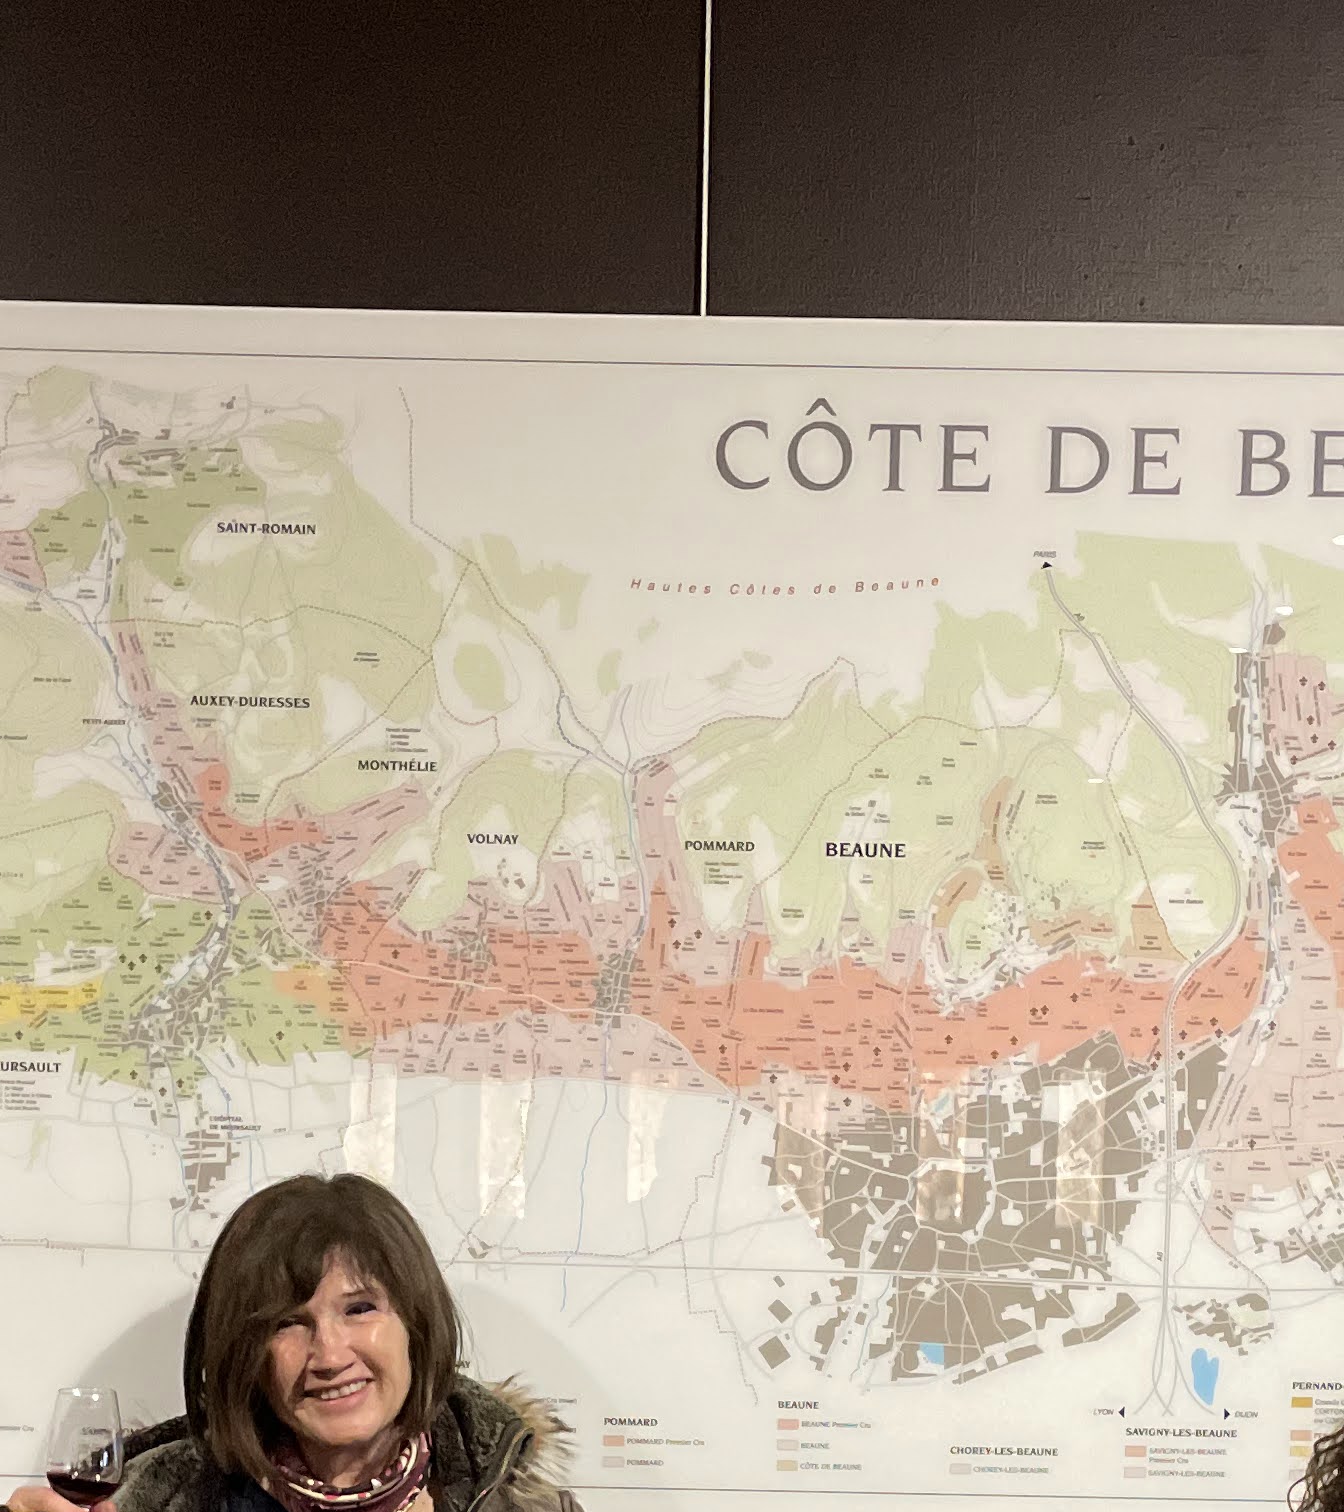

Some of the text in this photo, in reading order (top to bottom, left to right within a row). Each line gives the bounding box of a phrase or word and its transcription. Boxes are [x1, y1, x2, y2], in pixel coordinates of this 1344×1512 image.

[715, 399, 992, 492] CÔTE
[1045, 425, 1182, 495] DE
[217, 520, 316, 535] SAINT-ROMAIN
[630, 578, 711, 595] Hautes
[814, 583, 836, 594] de
[855, 577, 939, 593] Beaune
[190, 695, 310, 709] AUXEY-DURESSES
[357, 758, 438, 773] MONTHÉLIE
[467, 832, 519, 846] VOLNAY
[684, 840, 755, 853] POMMARD
[825, 843, 906, 859] BEAUNE
[778, 1400, 819, 1410] BEAUNE
[604, 1417, 658, 1427] POMMARD
[1126, 1428, 1238, 1438] SAVIGNY-LES-BEAUNE
[950, 1446, 1059, 1457] CHOREY-LES-BEAUNE
